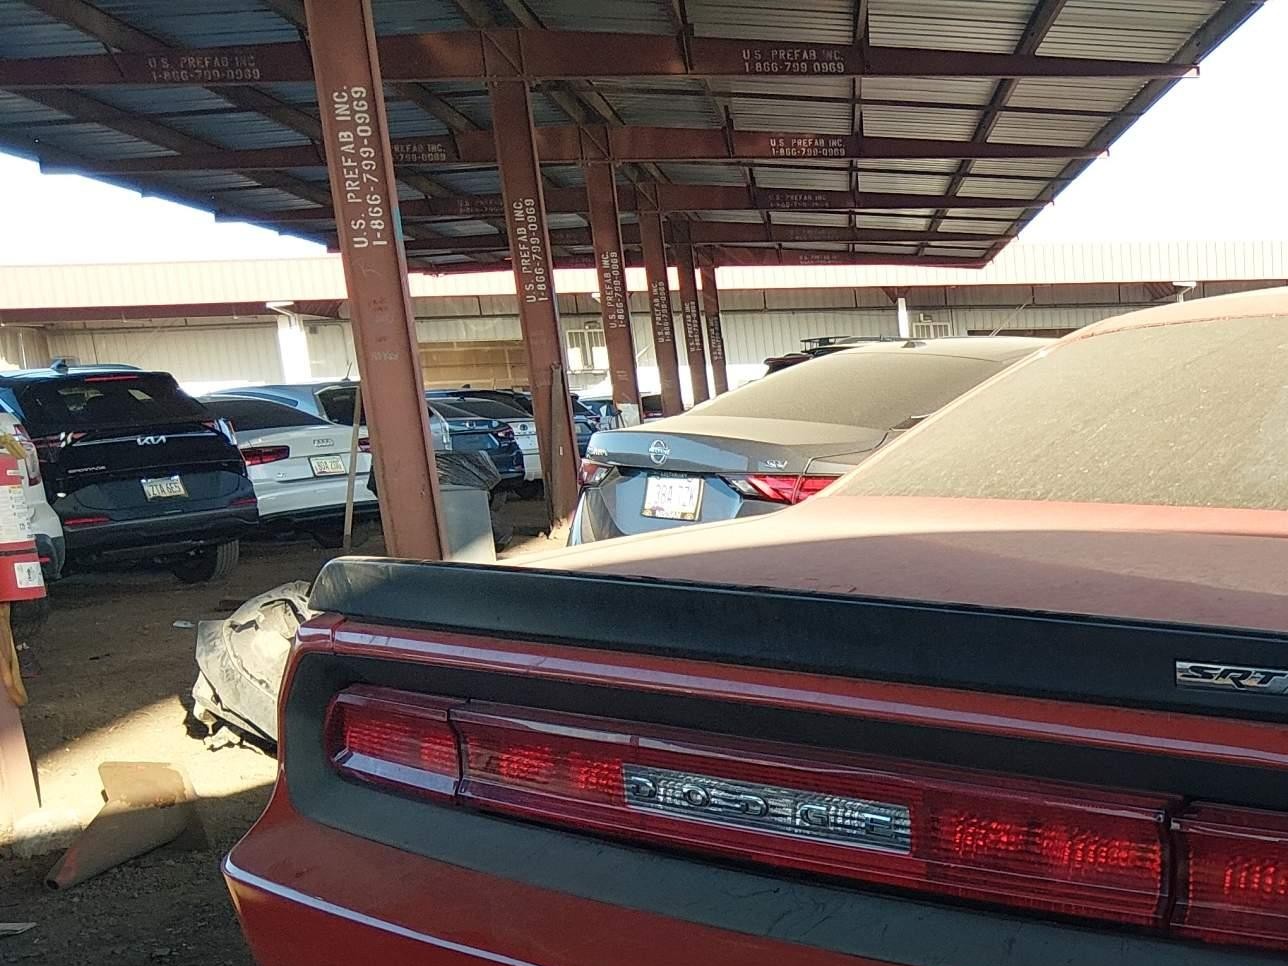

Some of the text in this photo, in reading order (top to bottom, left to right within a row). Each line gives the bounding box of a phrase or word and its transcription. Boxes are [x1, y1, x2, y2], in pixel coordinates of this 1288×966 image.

[771, 49, 817, 60] PREFAB
[333, 85, 369, 248] U.S. PREFAB INC.
[351, 86, 388, 245] 1-866-799-0969
[513, 198, 537, 303] U.S. PREFAB INC.
[524, 199, 549, 301] 1-866-799-0969
[603, 272, 615, 307] PREFAB
[630, 775, 896, 838] DODGE
